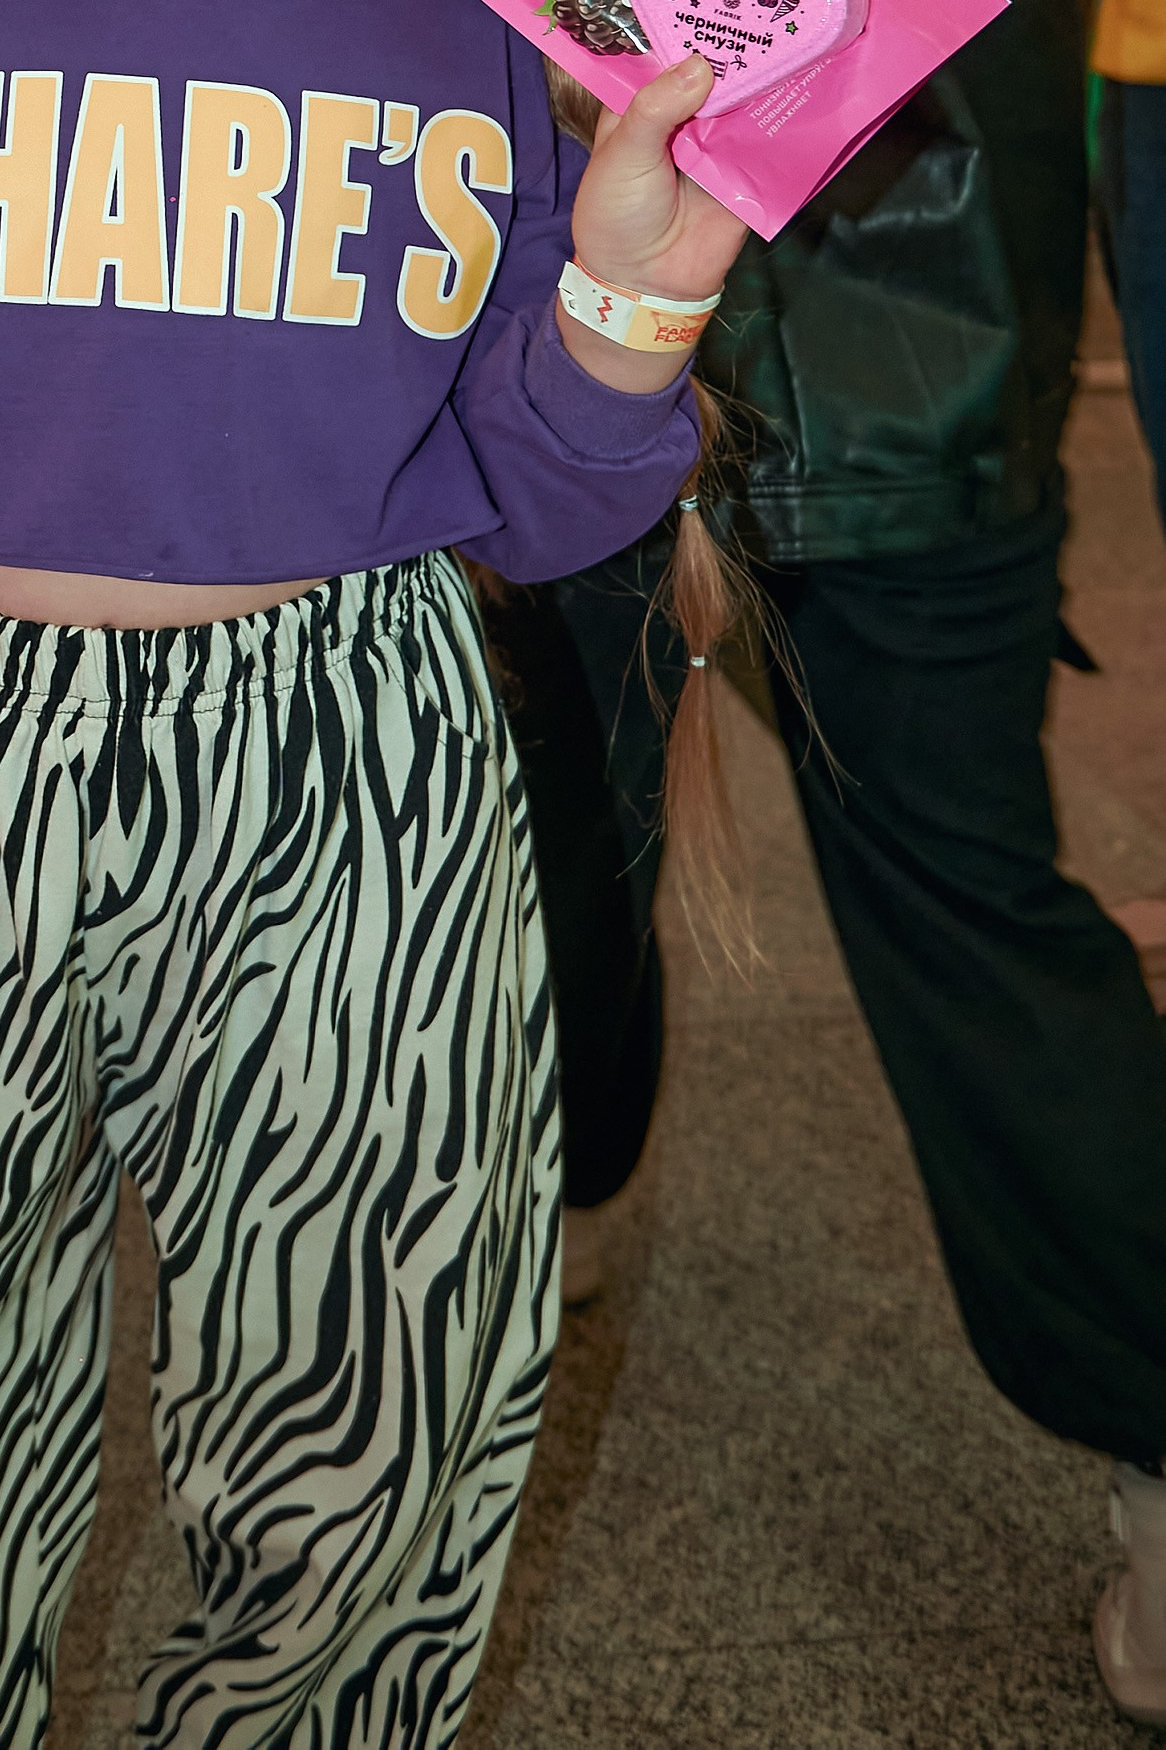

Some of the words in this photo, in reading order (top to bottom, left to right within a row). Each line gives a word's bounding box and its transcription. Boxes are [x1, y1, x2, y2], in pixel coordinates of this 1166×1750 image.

[675, 11, 774, 48] черничный
[694, 30, 746, 53] смузи
[765, 90, 812, 138] УВЛАЖНЯЕТ
